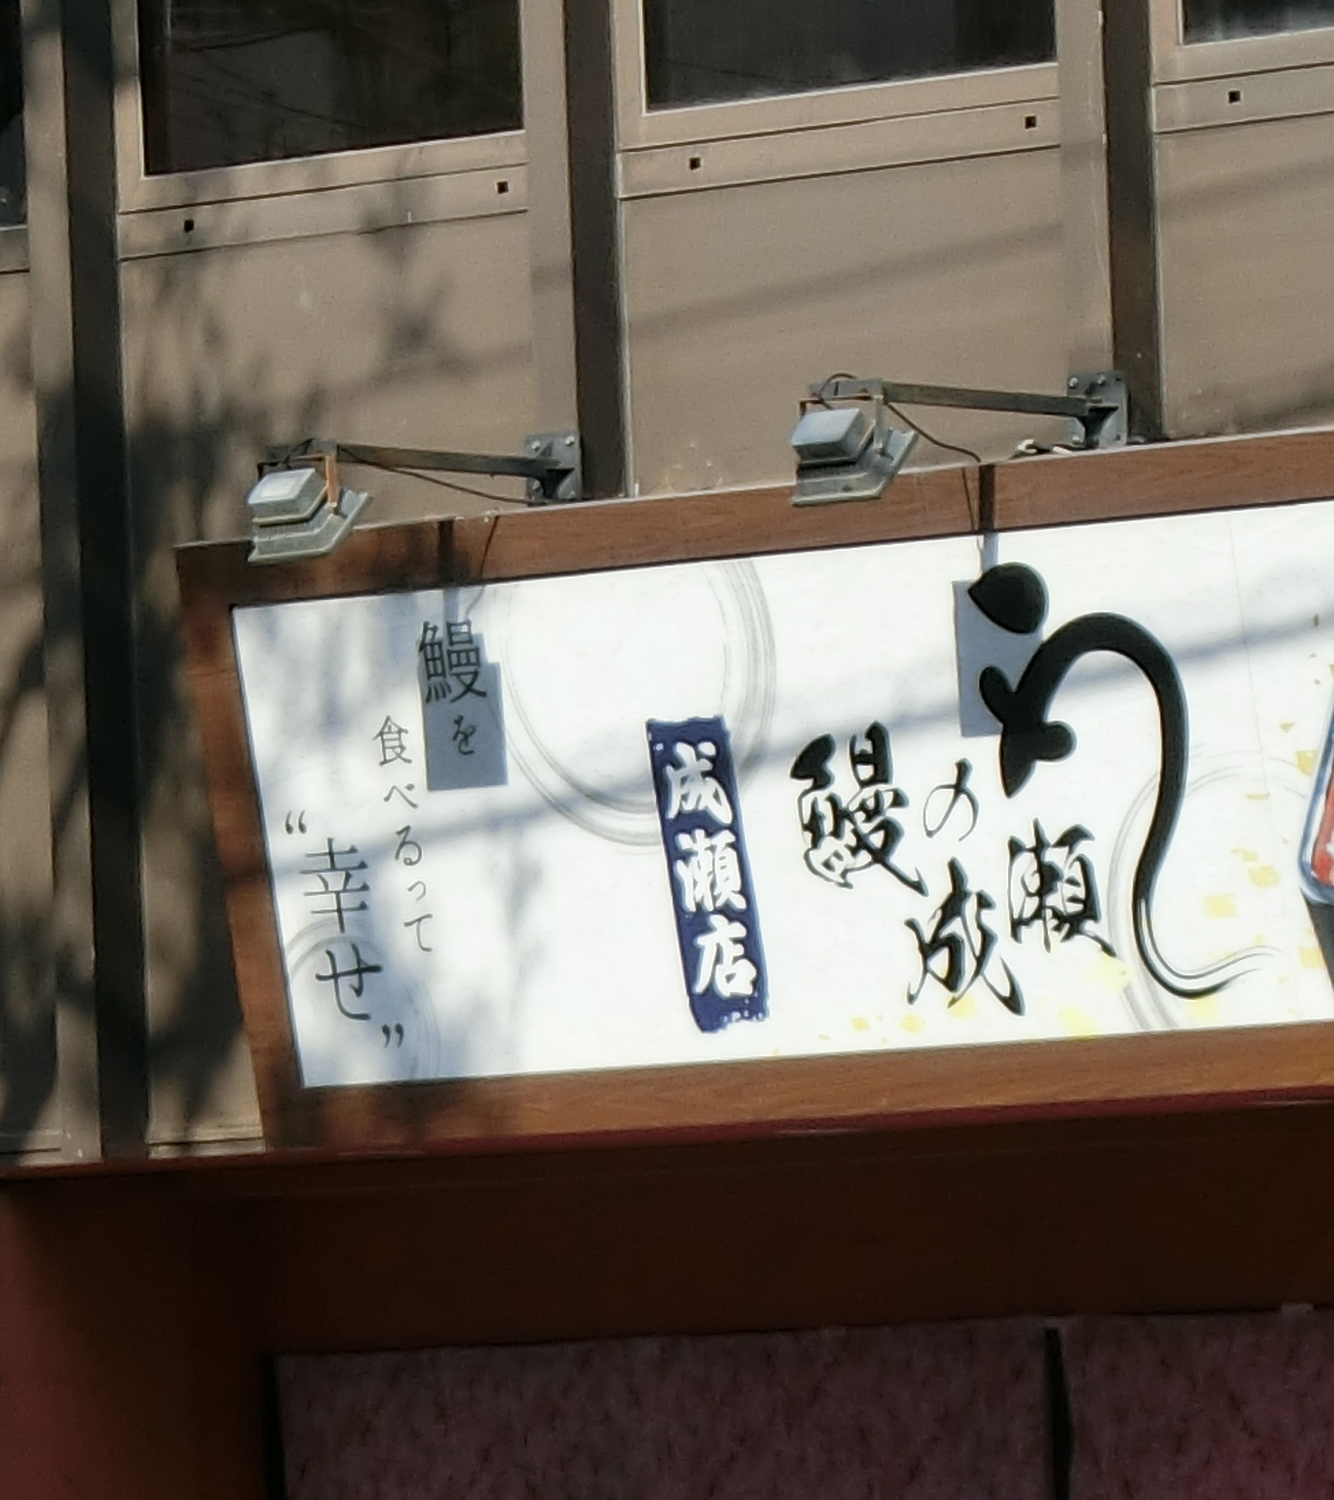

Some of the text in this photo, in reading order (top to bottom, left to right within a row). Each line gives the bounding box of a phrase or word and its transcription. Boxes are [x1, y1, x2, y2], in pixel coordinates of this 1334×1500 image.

[419, 618, 489, 758] 鰻を
[371, 715, 436, 956] 食べるって
[661, 738, 763, 998] 成瀬店
